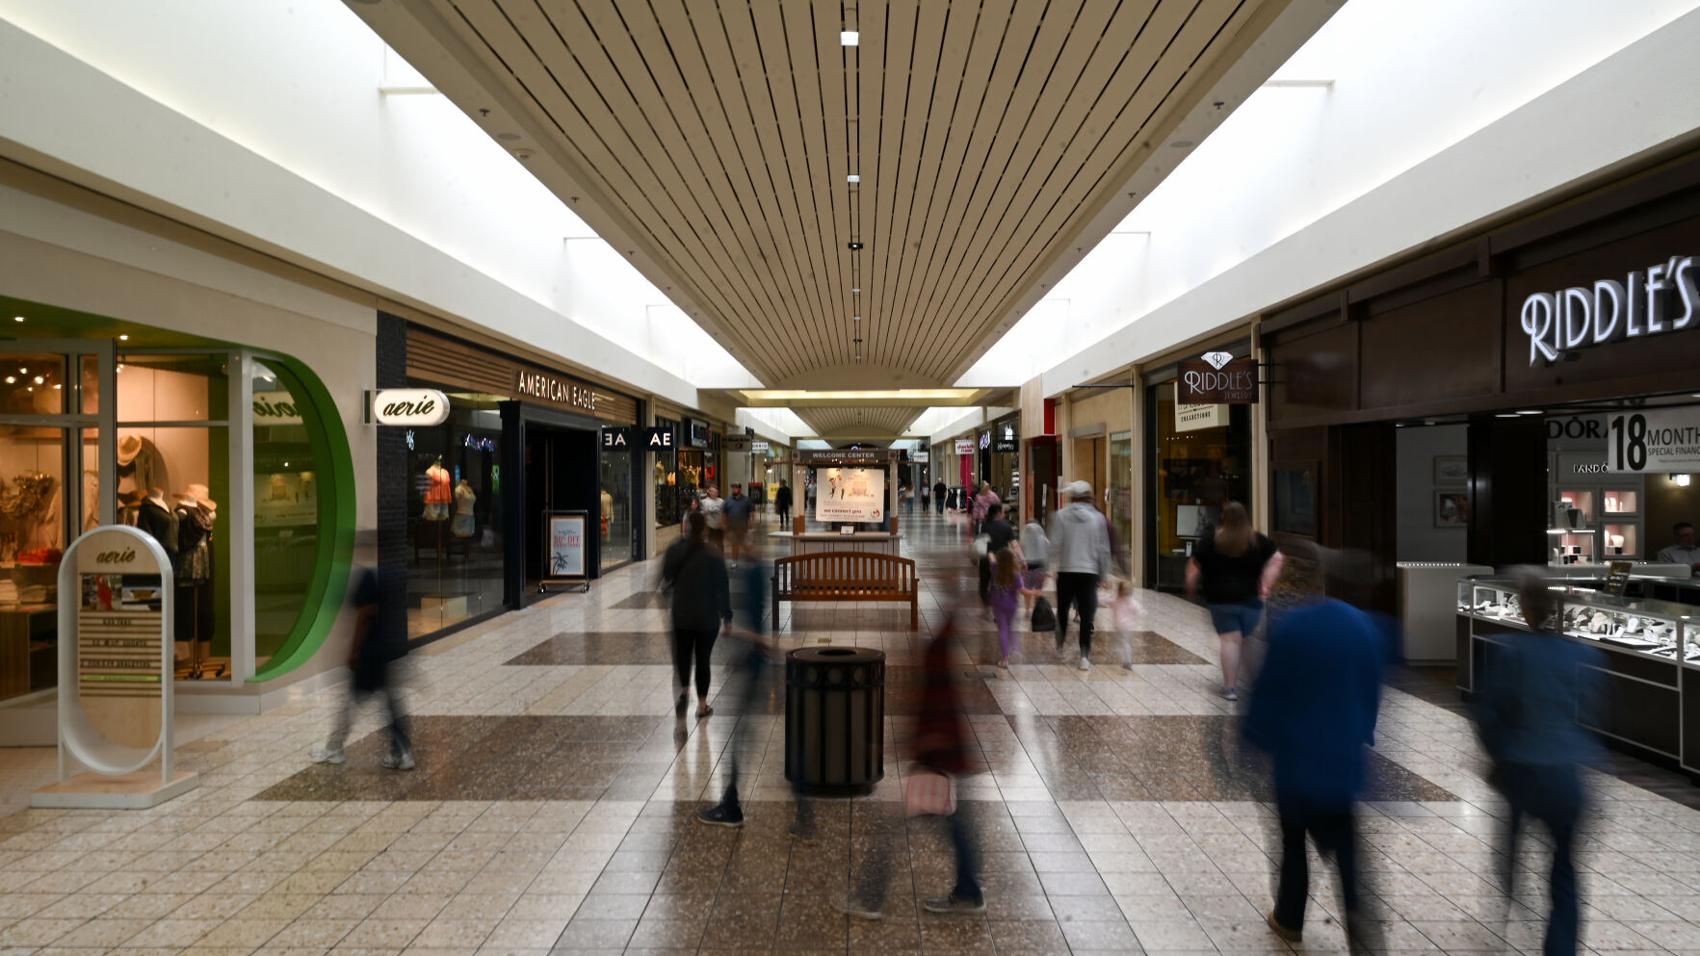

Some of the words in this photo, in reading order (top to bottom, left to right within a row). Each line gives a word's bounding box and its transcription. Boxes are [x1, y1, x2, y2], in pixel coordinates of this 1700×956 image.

[1521, 255, 1699, 367] RIDDLE'S
[518, 370, 569, 402] AMERICAN
[573, 386, 596, 410] EAGLE
[1184, 370, 1253, 394] RIDDLE'S
[382, 395, 435, 417] aerie
[1181, 411, 1211, 422] COLLECTIONS
[650, 432, 671, 446] AE
[1611, 413, 1647, 471] 18
[1647, 447, 1674, 456] SPECIAL
[96, 546, 136, 564] aerie
